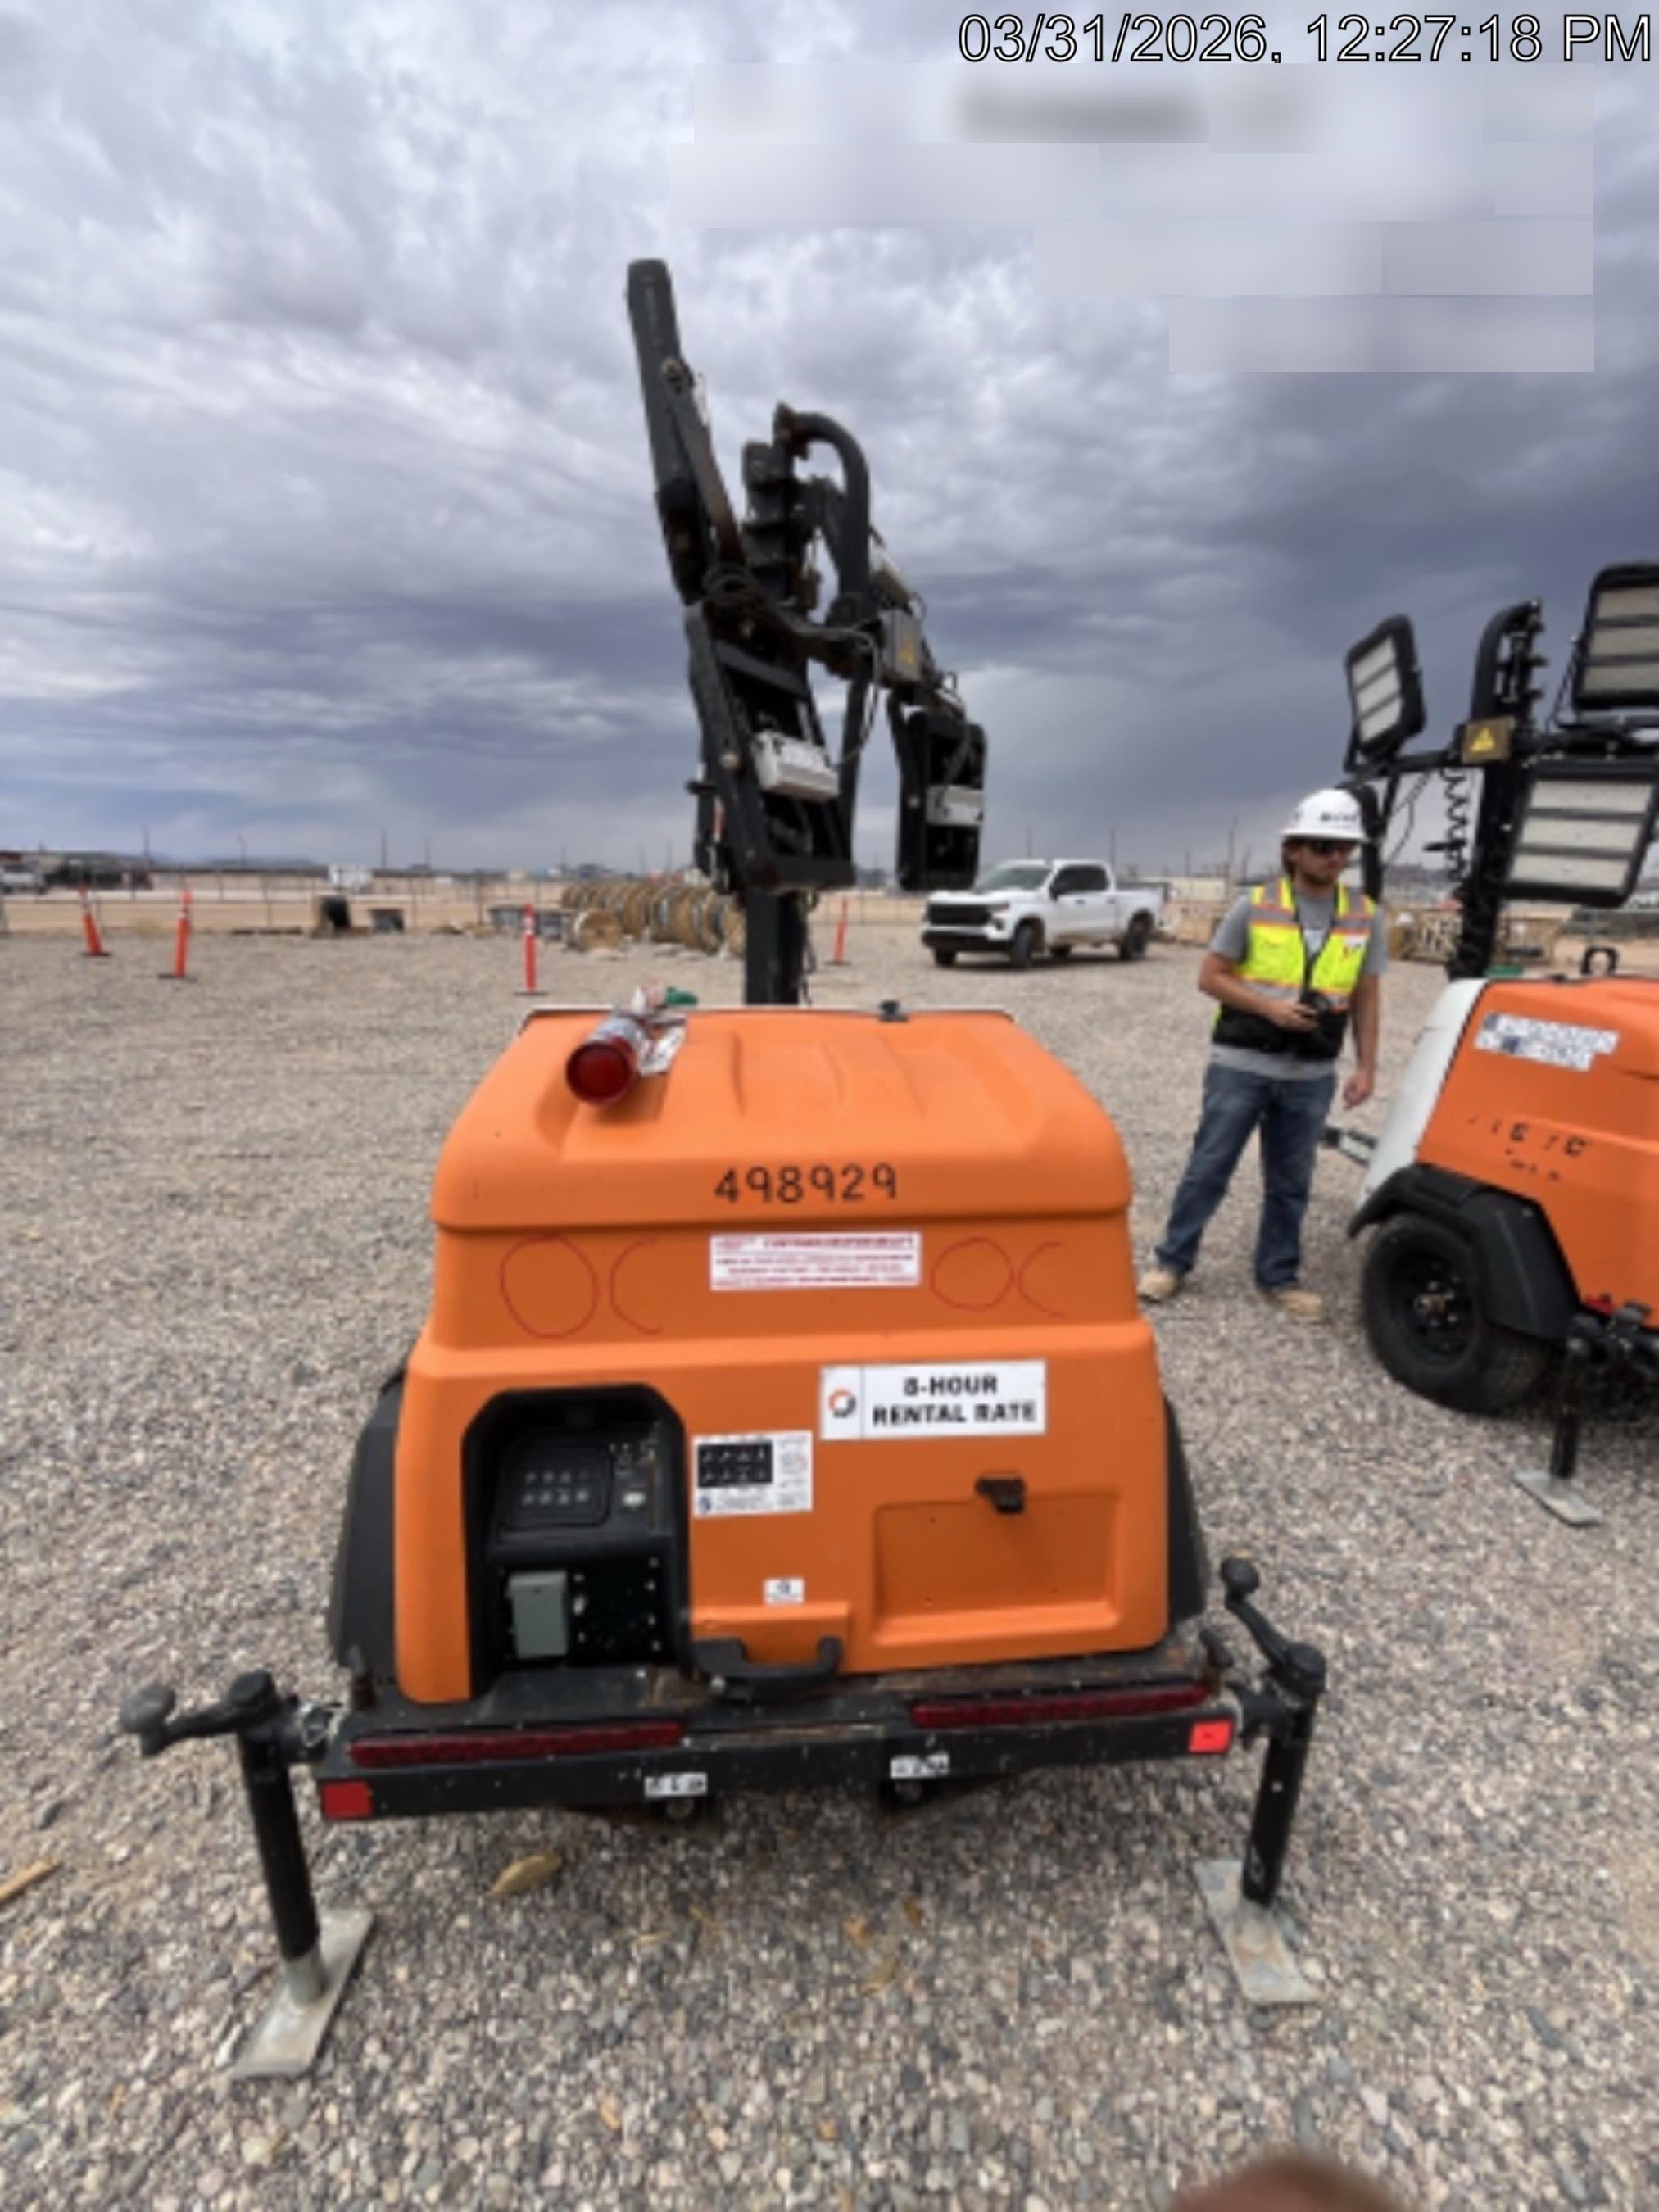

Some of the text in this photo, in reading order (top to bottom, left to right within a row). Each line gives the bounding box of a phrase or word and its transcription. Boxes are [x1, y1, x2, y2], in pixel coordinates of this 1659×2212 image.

[714, 1163, 897, 1203] 498929
[904, 1375, 999, 1396] 8-HOUR
[873, 1401, 1036, 1426] RENTAL RATE
